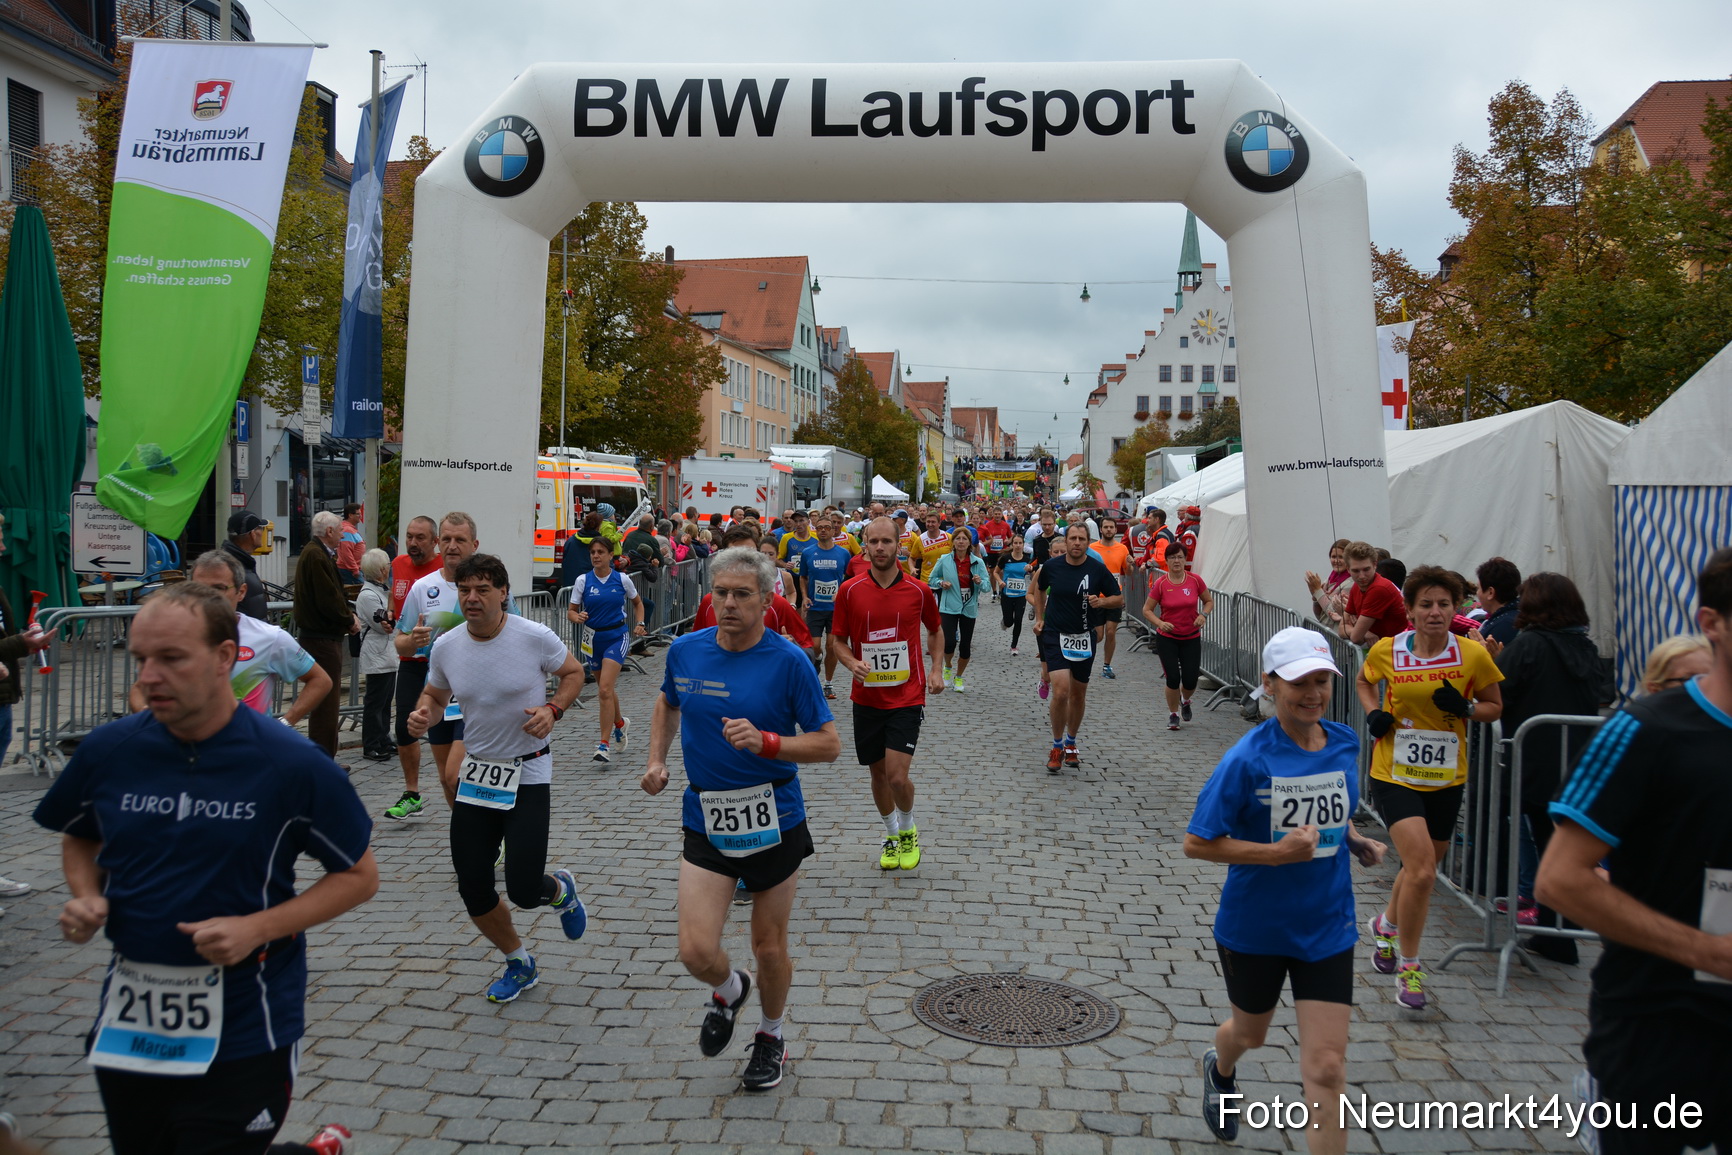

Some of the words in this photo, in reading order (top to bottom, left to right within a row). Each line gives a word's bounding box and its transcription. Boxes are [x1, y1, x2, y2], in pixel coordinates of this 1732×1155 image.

[574, 78, 789, 137] BMW
[811, 77, 1195, 151] Laufsport
[306, 355, 315, 379] P
[239, 406, 246, 437] P
[265, 456, 271, 469] 3
[404, 458, 513, 472] www.bmw-laufsport.de
[1267, 457, 1384, 473] www.bmw-laufsport.de
[84, 522, 117, 531] Kreuzung
[88, 542, 131, 551] Kaserngasse
[816, 585, 837, 595] 2672
[1008, 581, 1025, 590] 2157
[1063, 637, 1089, 650] 2209
[871, 652, 900, 670] 157
[1393, 674, 1423, 684] MAX
[1428, 670, 1464, 683] BÖGL
[1396, 733, 1418, 741] PARTL
[1418, 734, 1449, 742] Neumarkt
[1407, 742, 1446, 765] 364
[465, 761, 516, 788] 2797
[1405, 767, 1444, 779] Marianne
[475, 788, 497, 800] Peter
[1274, 783, 1304, 793] PARTL
[1305, 781, 1336, 793] Neumarkt
[702, 797, 725, 805] PARTL
[726, 792, 762, 804] Neumarkt
[120, 793, 175, 814] EURO
[193, 800, 257, 819] POLES
[1281, 793, 1344, 828] 2786
[709, 801, 771, 832] 2518
[723, 834, 762, 849] Michael
[142, 973, 200, 987] Neumarkt
[117, 984, 211, 1031] 2155
[130, 1036, 187, 1058] Marcus
